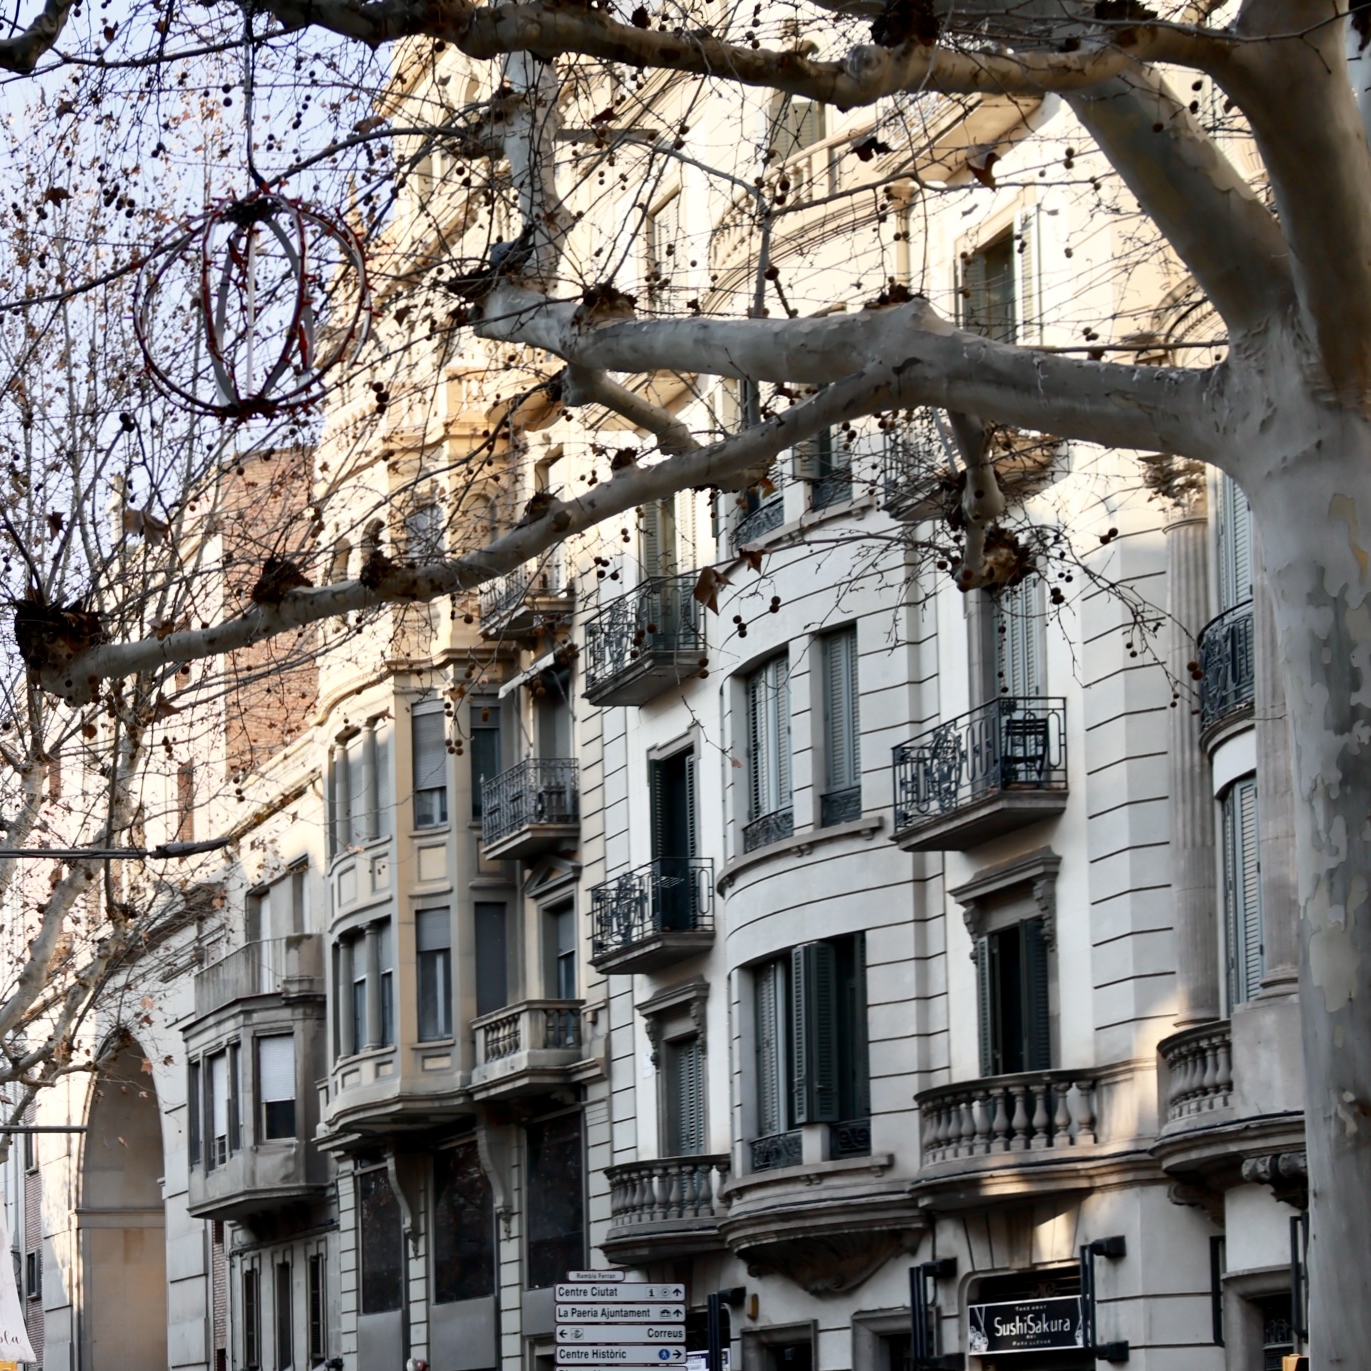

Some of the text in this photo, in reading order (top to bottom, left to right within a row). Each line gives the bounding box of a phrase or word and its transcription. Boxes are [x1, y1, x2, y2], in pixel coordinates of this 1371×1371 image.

[558, 1286, 618, 1297] Centre Ciutat
[558, 1307, 651, 1320] La Paeria Ajuntament
[994, 1313, 1070, 1337] SushiSakura
[647, 1327, 683, 1338] Correus
[559, 1349, 627, 1359] Centre Històric
